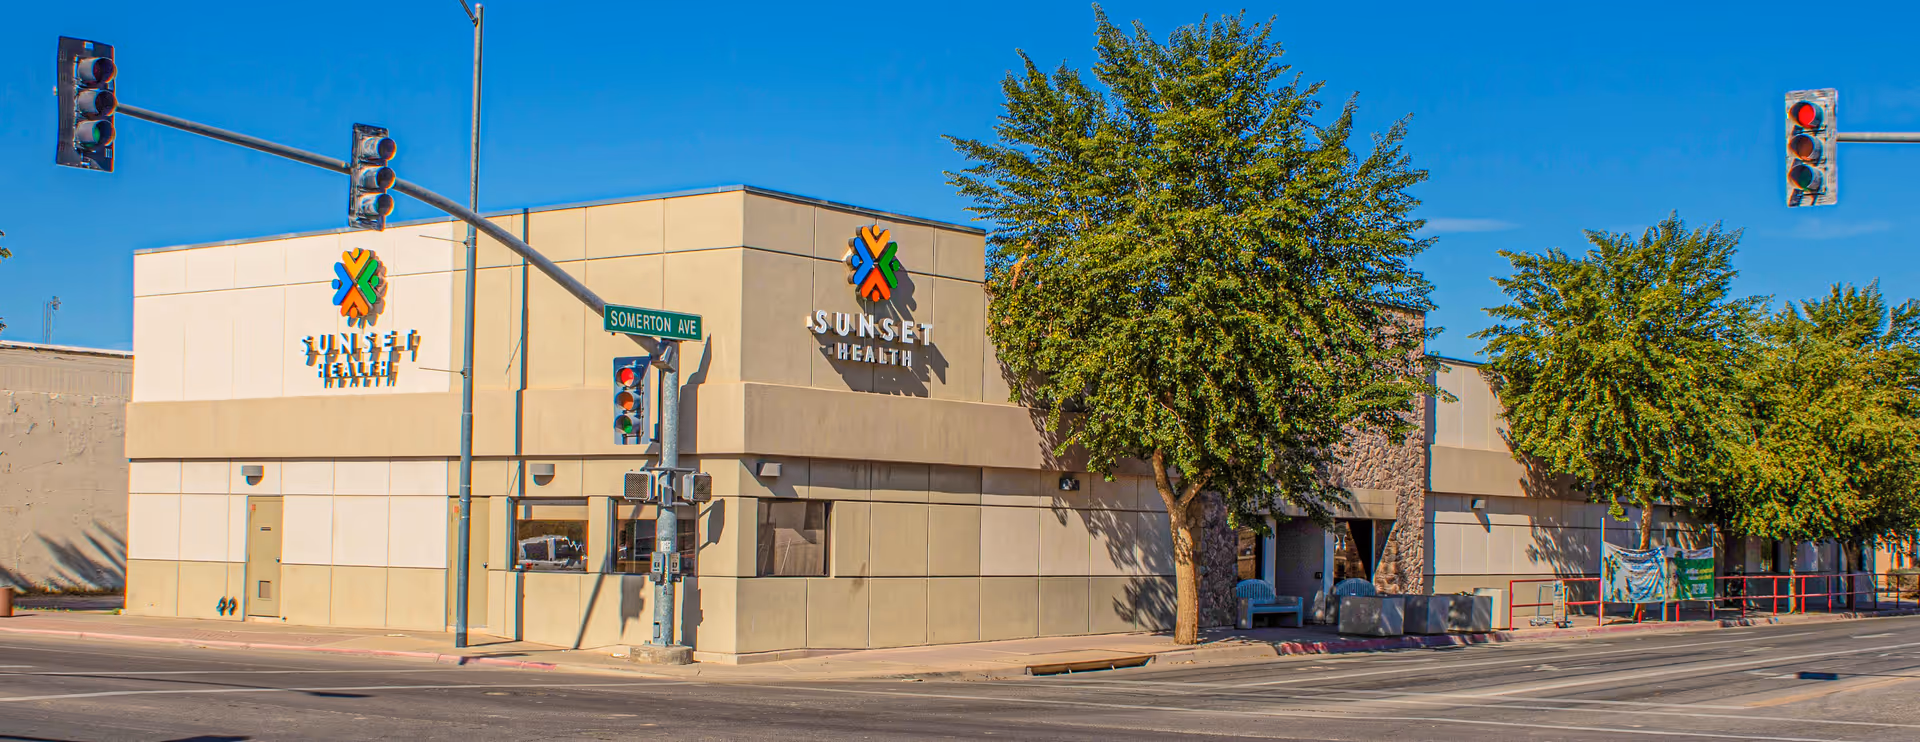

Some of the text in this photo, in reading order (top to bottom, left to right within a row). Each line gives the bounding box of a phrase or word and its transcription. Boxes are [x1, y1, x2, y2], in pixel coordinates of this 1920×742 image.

[610, 310, 697, 336] SOMERTON AVE
[813, 309, 933, 346] SUNSET
[299, 329, 419, 356] SUNSET
[835, 342, 912, 367] HEALTH
[317, 361, 395, 378] HEALTH
